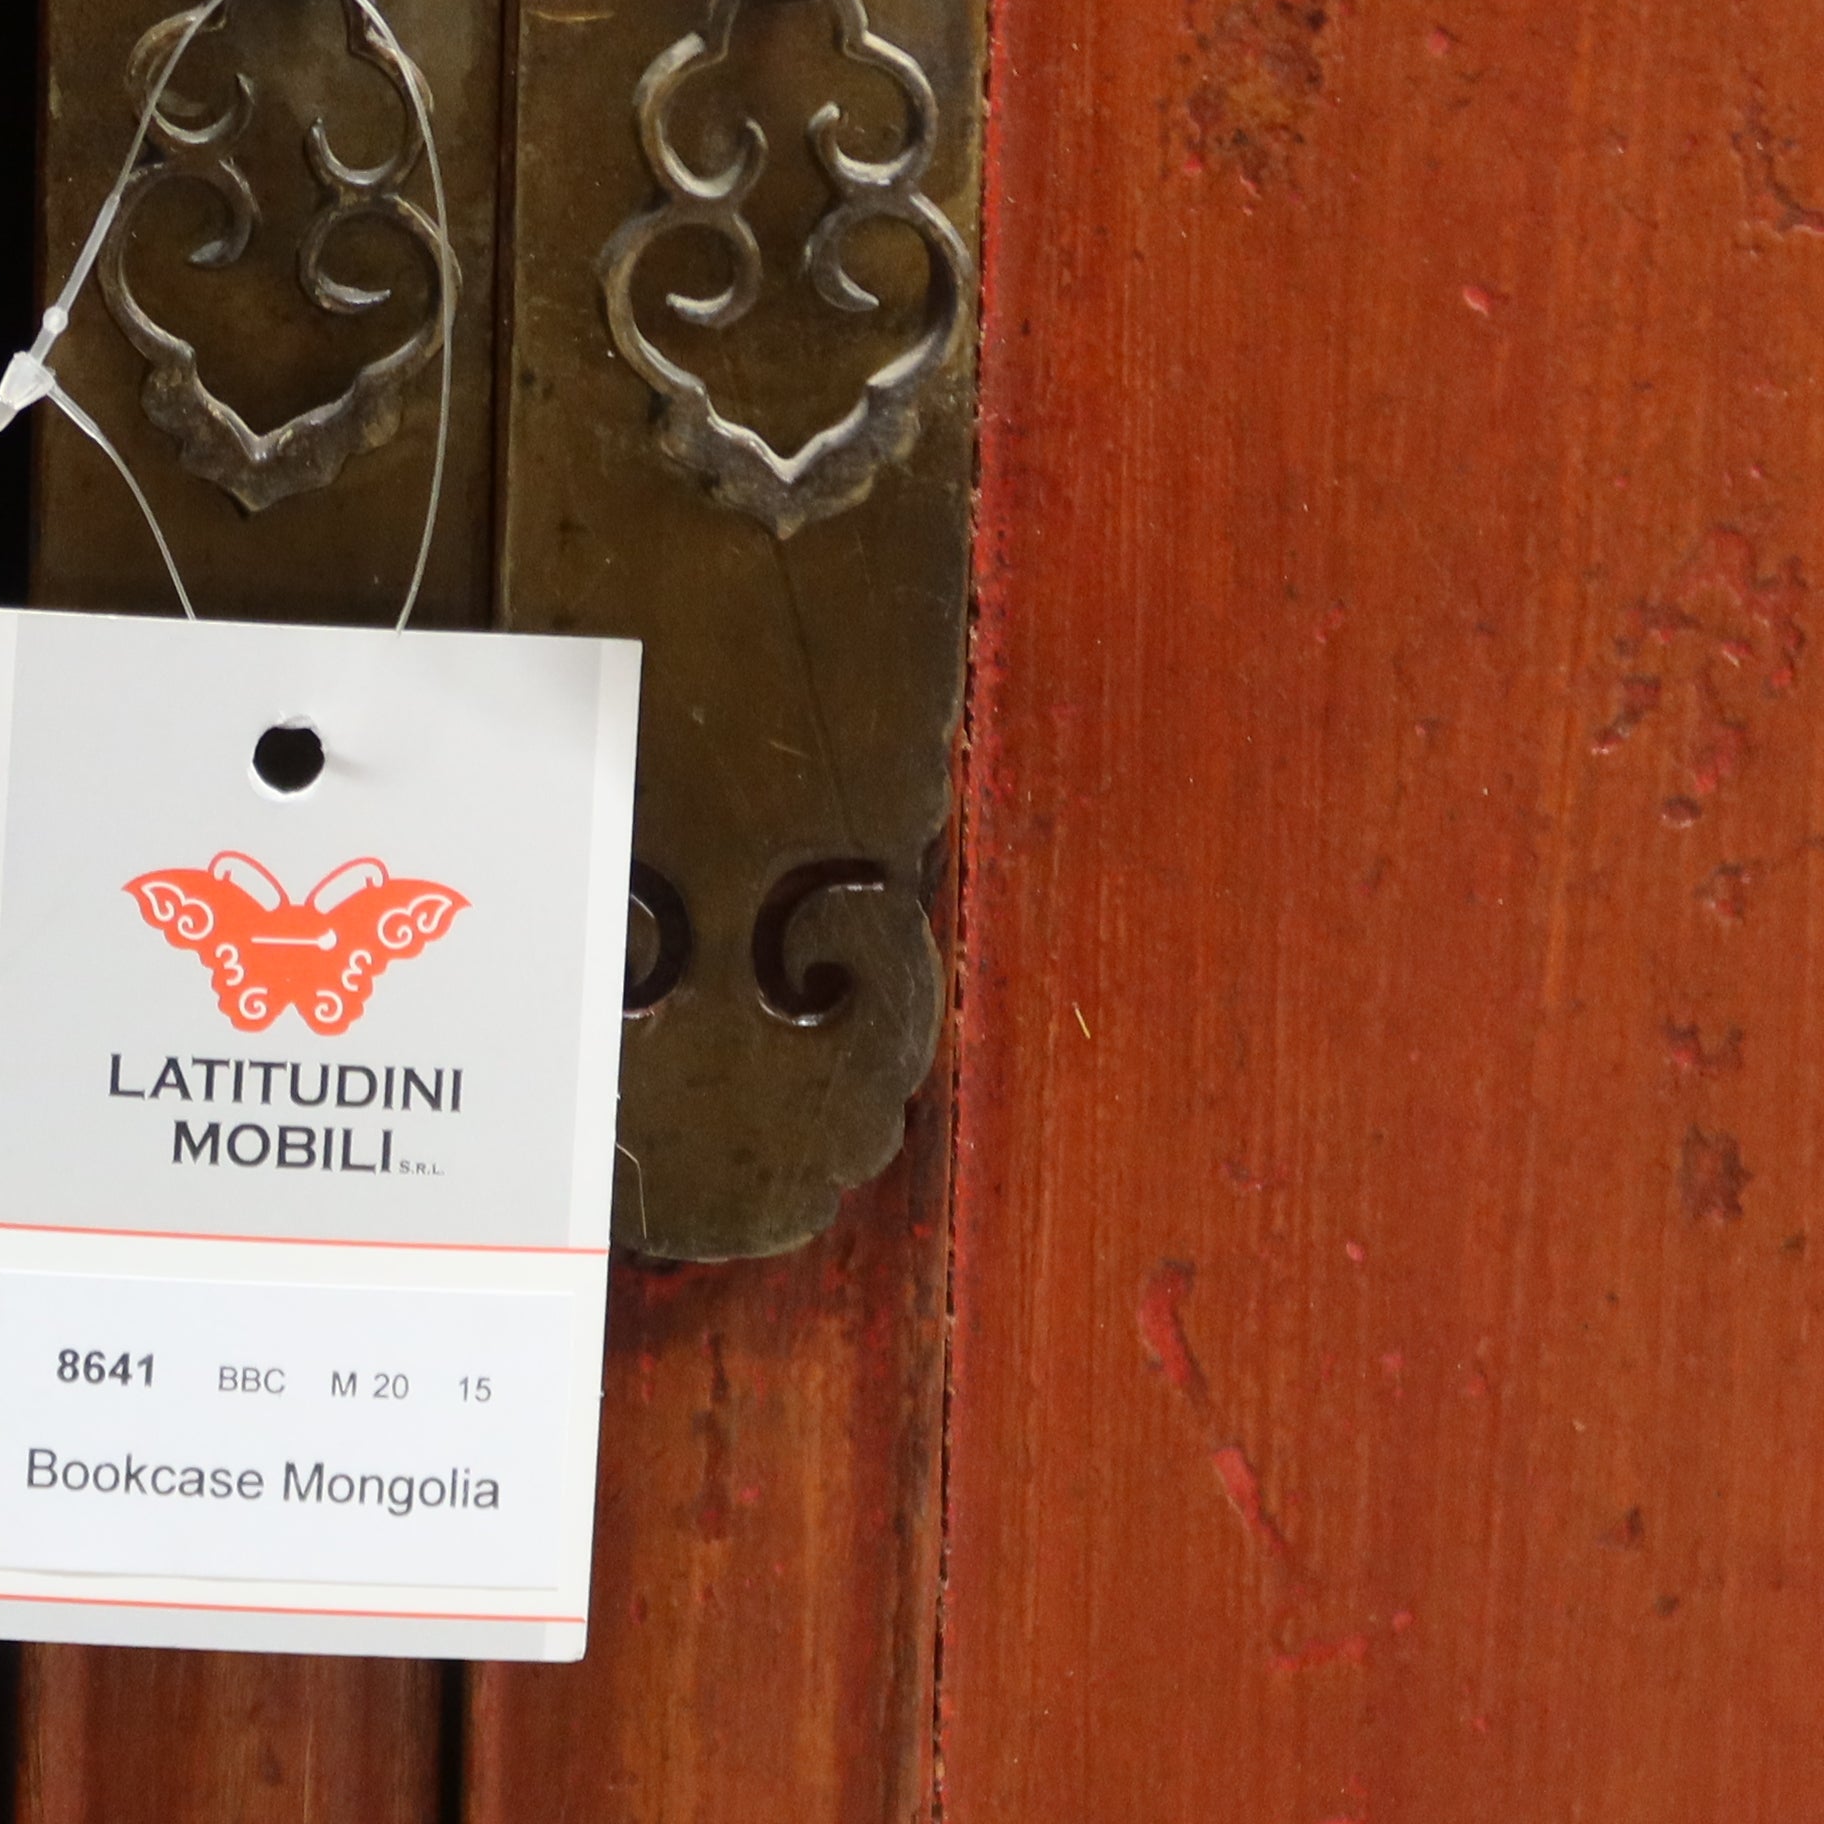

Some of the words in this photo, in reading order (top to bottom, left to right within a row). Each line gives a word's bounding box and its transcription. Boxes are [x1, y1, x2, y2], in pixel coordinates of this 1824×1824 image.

[108, 1052, 464, 1113] LATITUDINI
[172, 1119, 393, 1174] MOBILI
[56, 1348, 155, 1387] 8641
[217, 1365, 287, 1396] BBC
[330, 1370, 359, 1398] M
[372, 1373, 411, 1401] 20
[458, 1376, 493, 1403] 15
[26, 1447, 265, 1500] Bookcase
[282, 1461, 501, 1516] Mongolia
